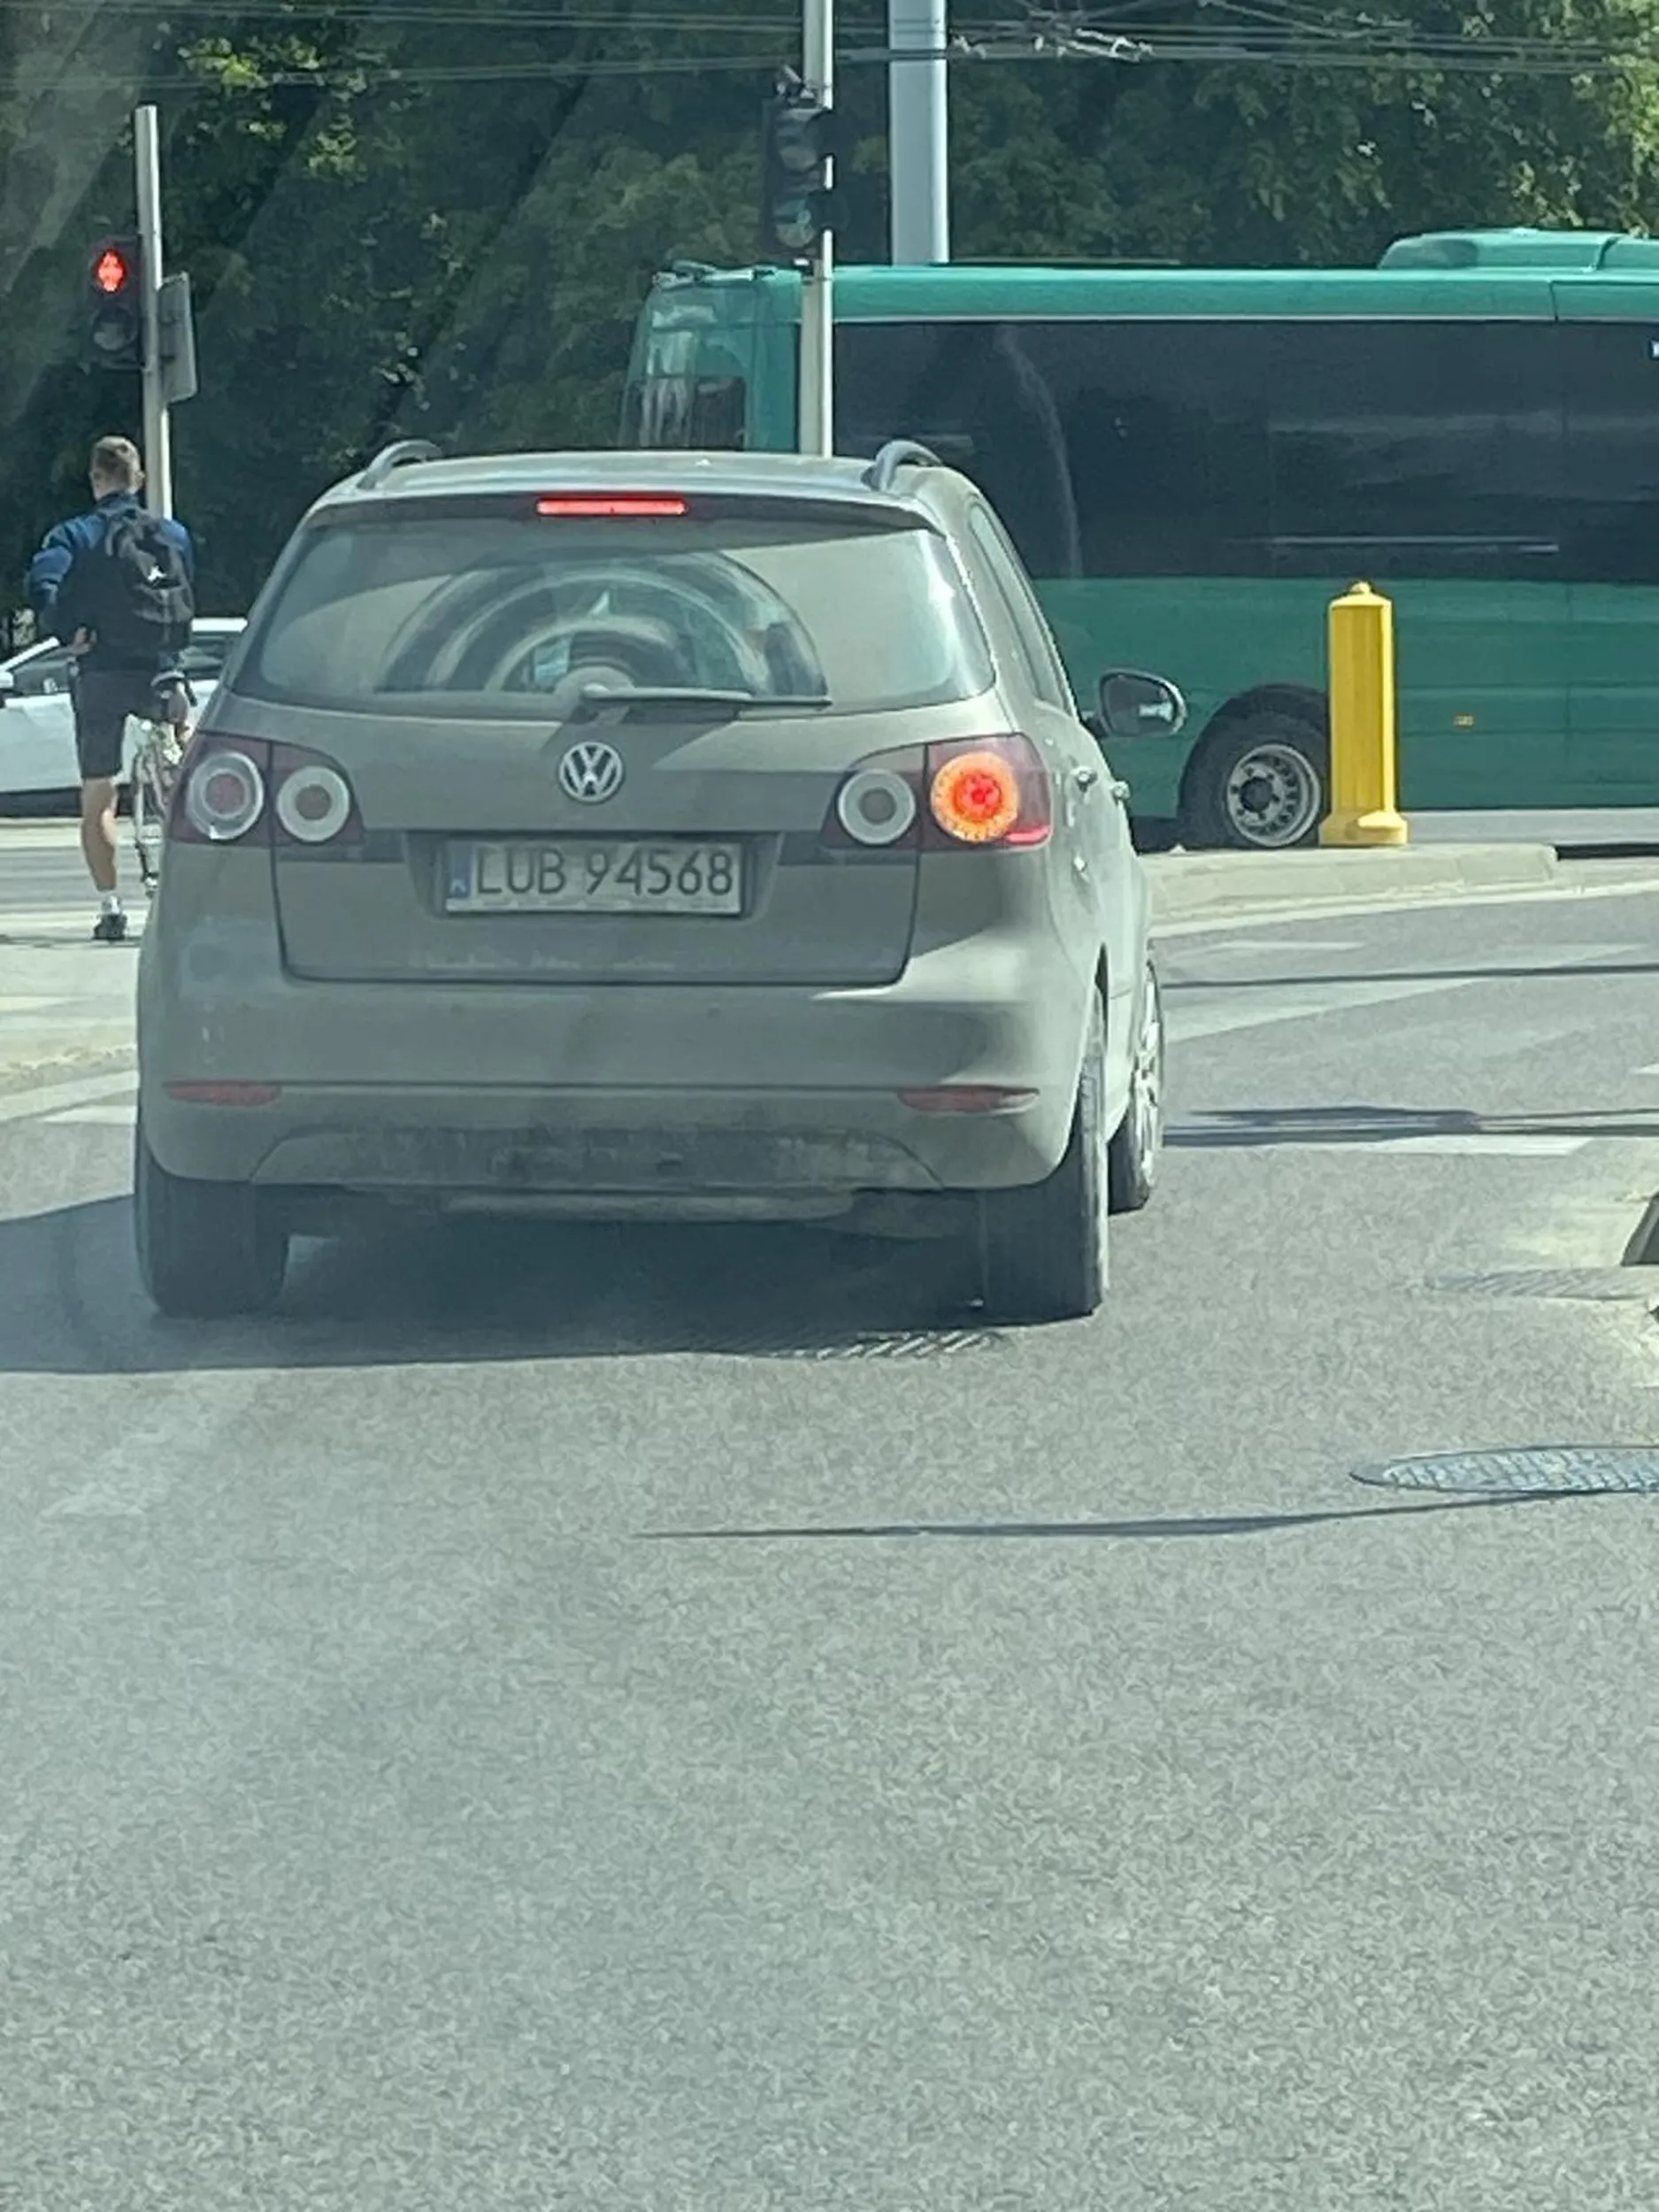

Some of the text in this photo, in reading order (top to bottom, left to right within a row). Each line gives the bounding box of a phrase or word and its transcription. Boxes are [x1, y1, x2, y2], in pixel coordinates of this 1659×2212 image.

[560, 742, 622, 801] VW
[477, 847, 733, 895] LUB 94568
